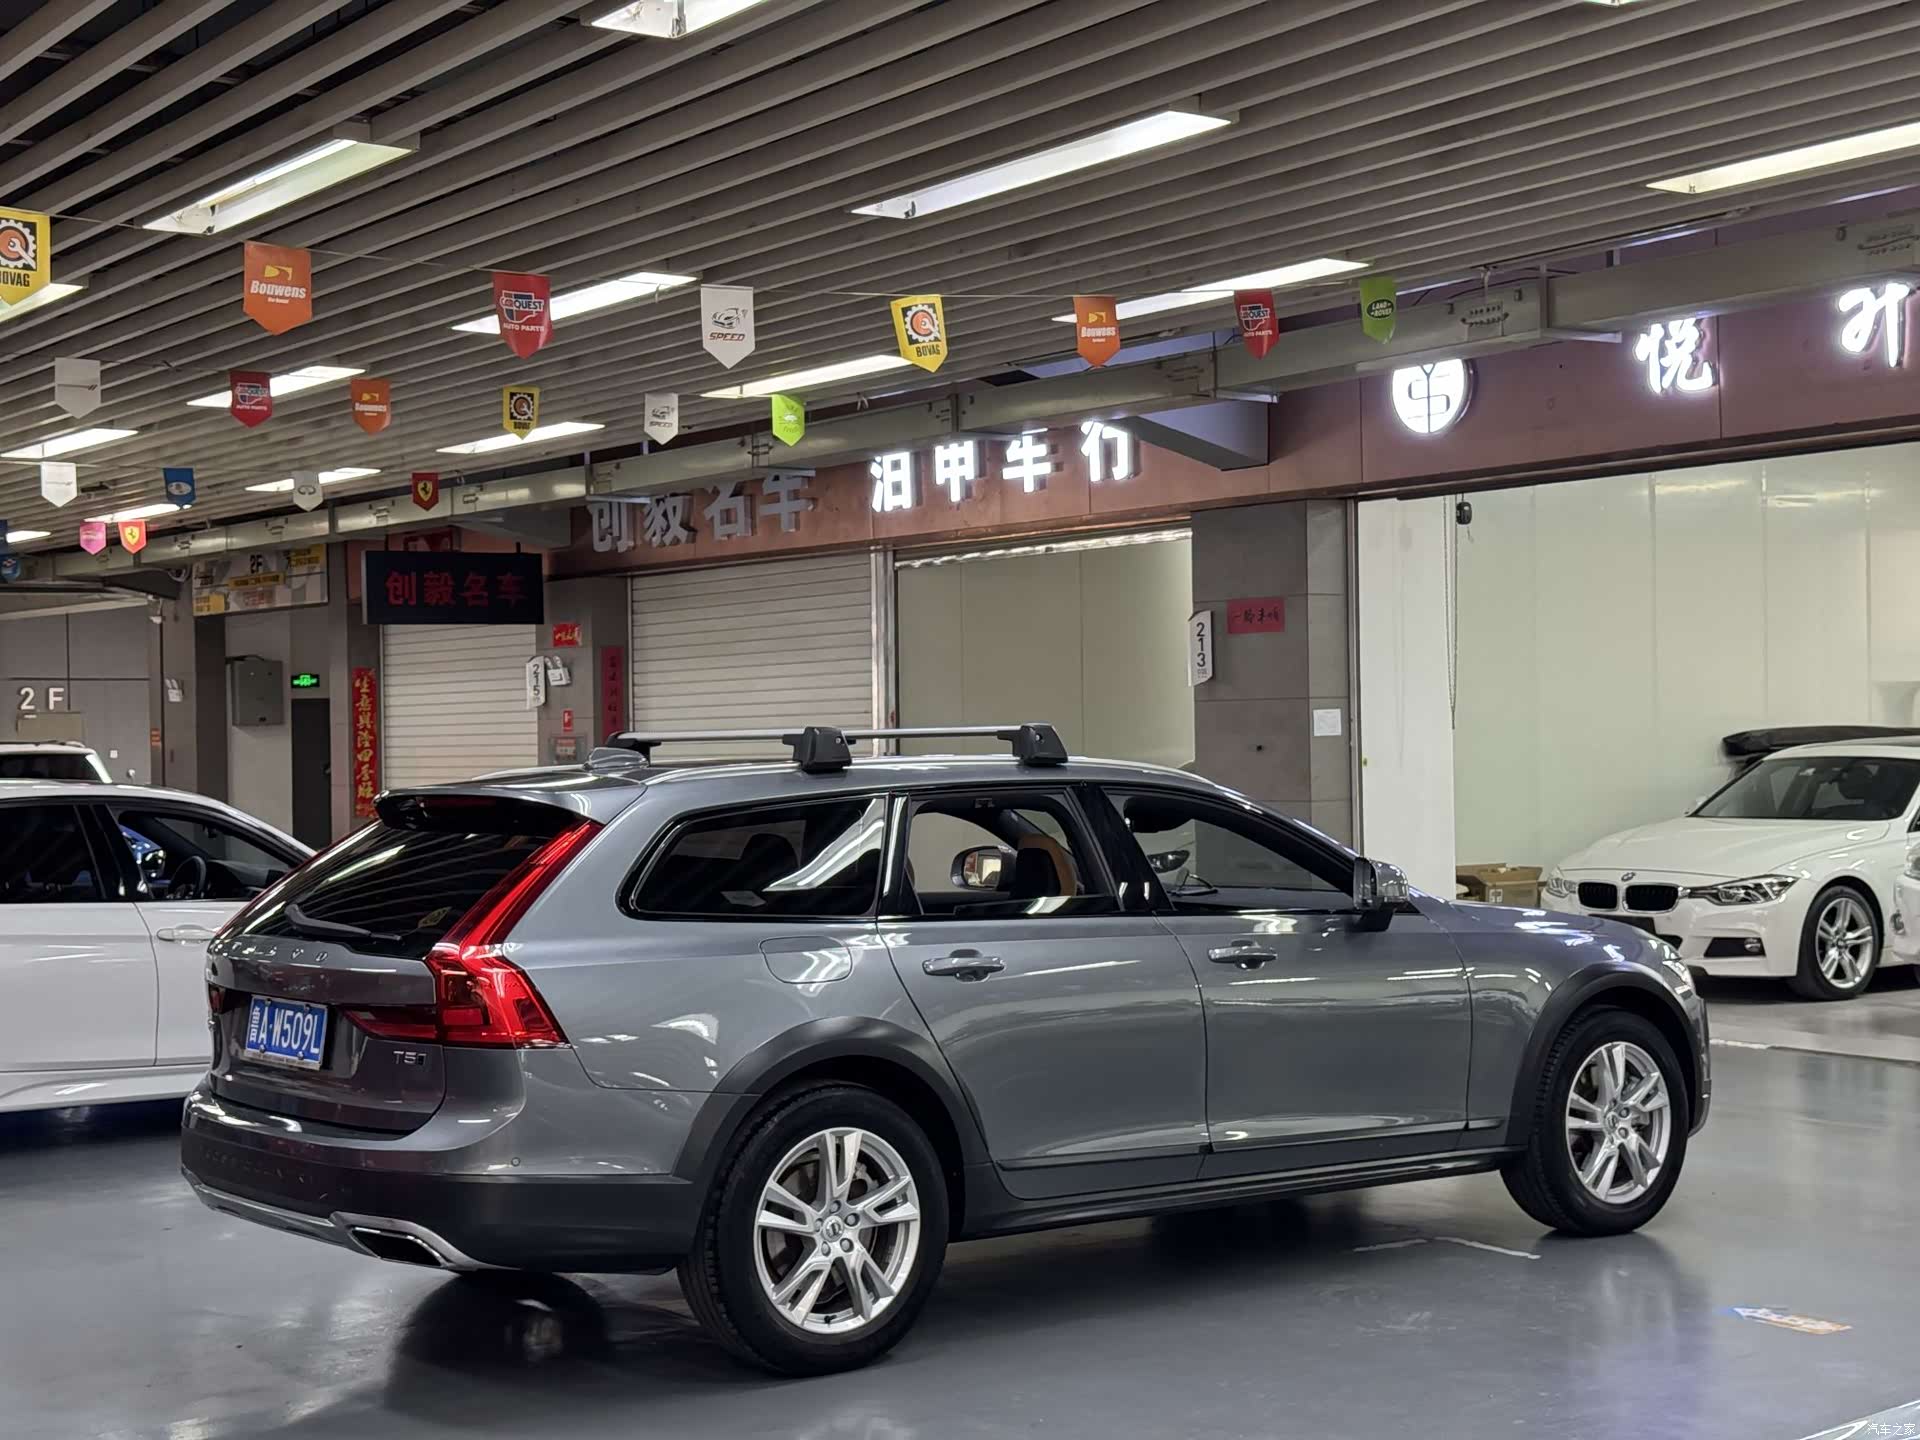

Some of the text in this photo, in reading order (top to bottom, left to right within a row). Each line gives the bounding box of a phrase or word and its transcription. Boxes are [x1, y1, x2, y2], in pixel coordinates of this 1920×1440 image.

[0, 271, 30, 287] OVAG
[250, 280, 306, 299] Bouwens
[1371, 301, 1388, 310] LAND
[503, 322, 545, 332] AUTO PARTS
[709, 332, 746, 342] SPEED
[915, 343, 941, 357] BOVAG
[1196, 622, 1206, 667] 213
